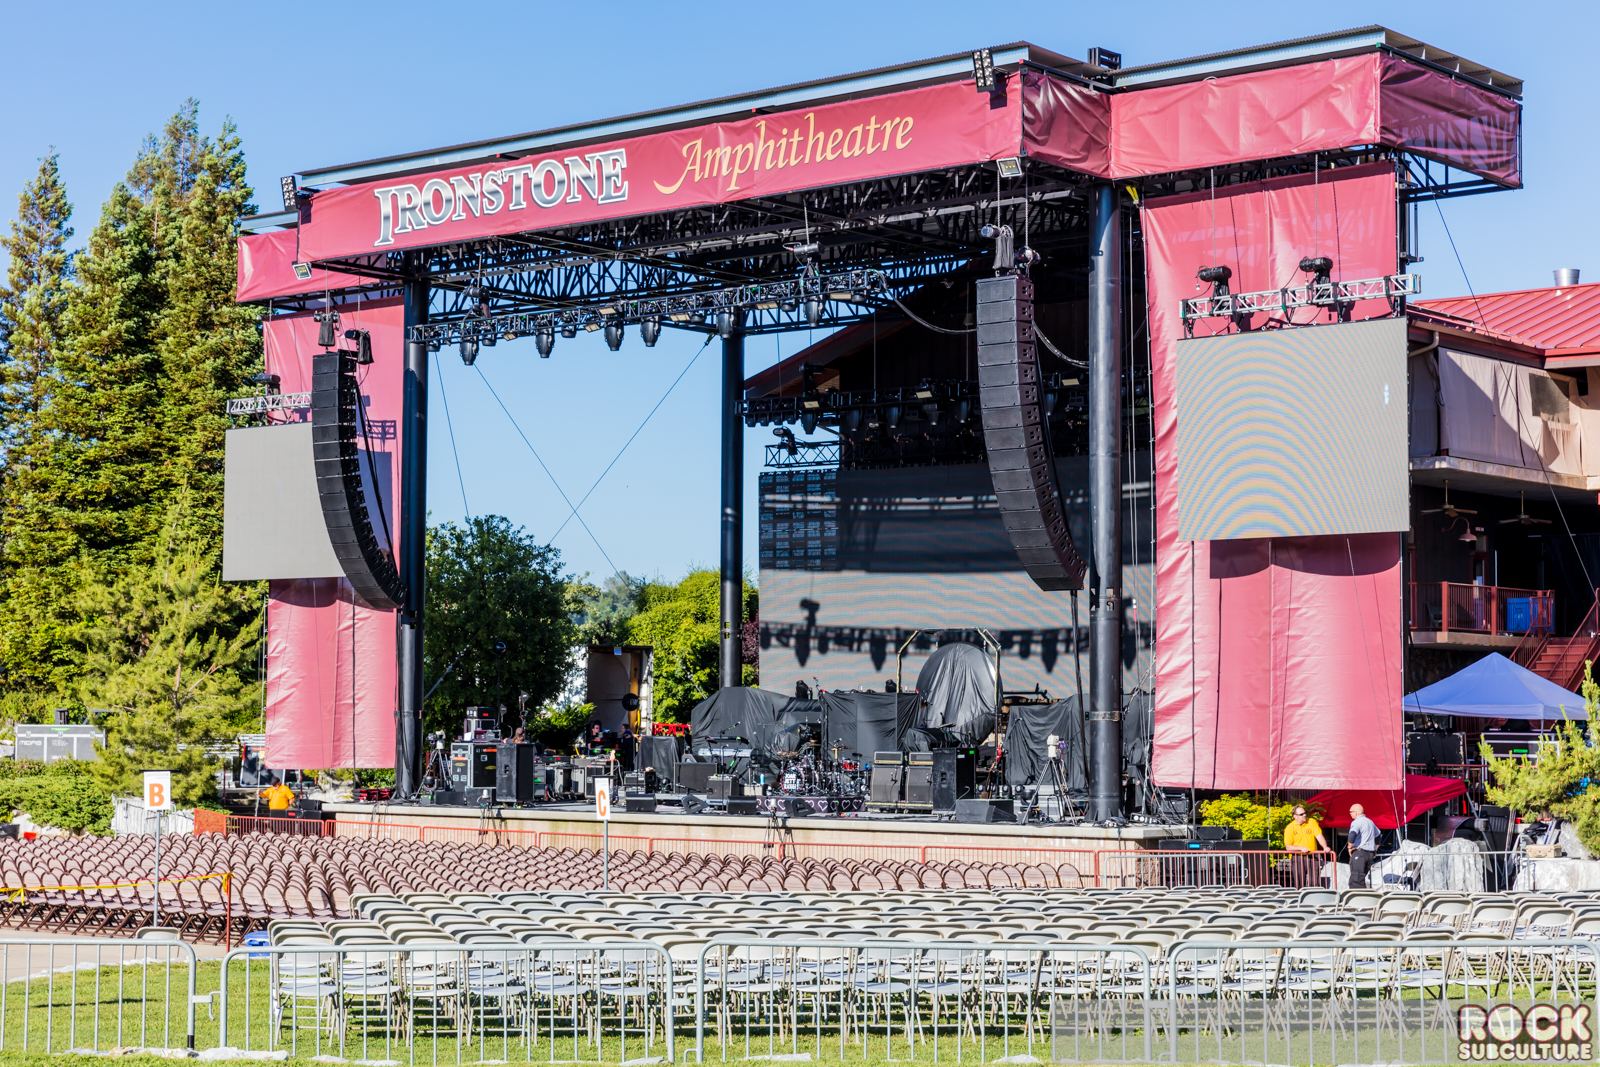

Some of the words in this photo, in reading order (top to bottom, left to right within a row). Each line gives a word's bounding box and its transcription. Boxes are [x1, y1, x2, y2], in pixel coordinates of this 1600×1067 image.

[374, 148, 629, 247] IRONSTONE
[653, 112, 914, 194] Amphitheatre
[149, 783, 165, 807] B
[598, 789, 607, 817] C
